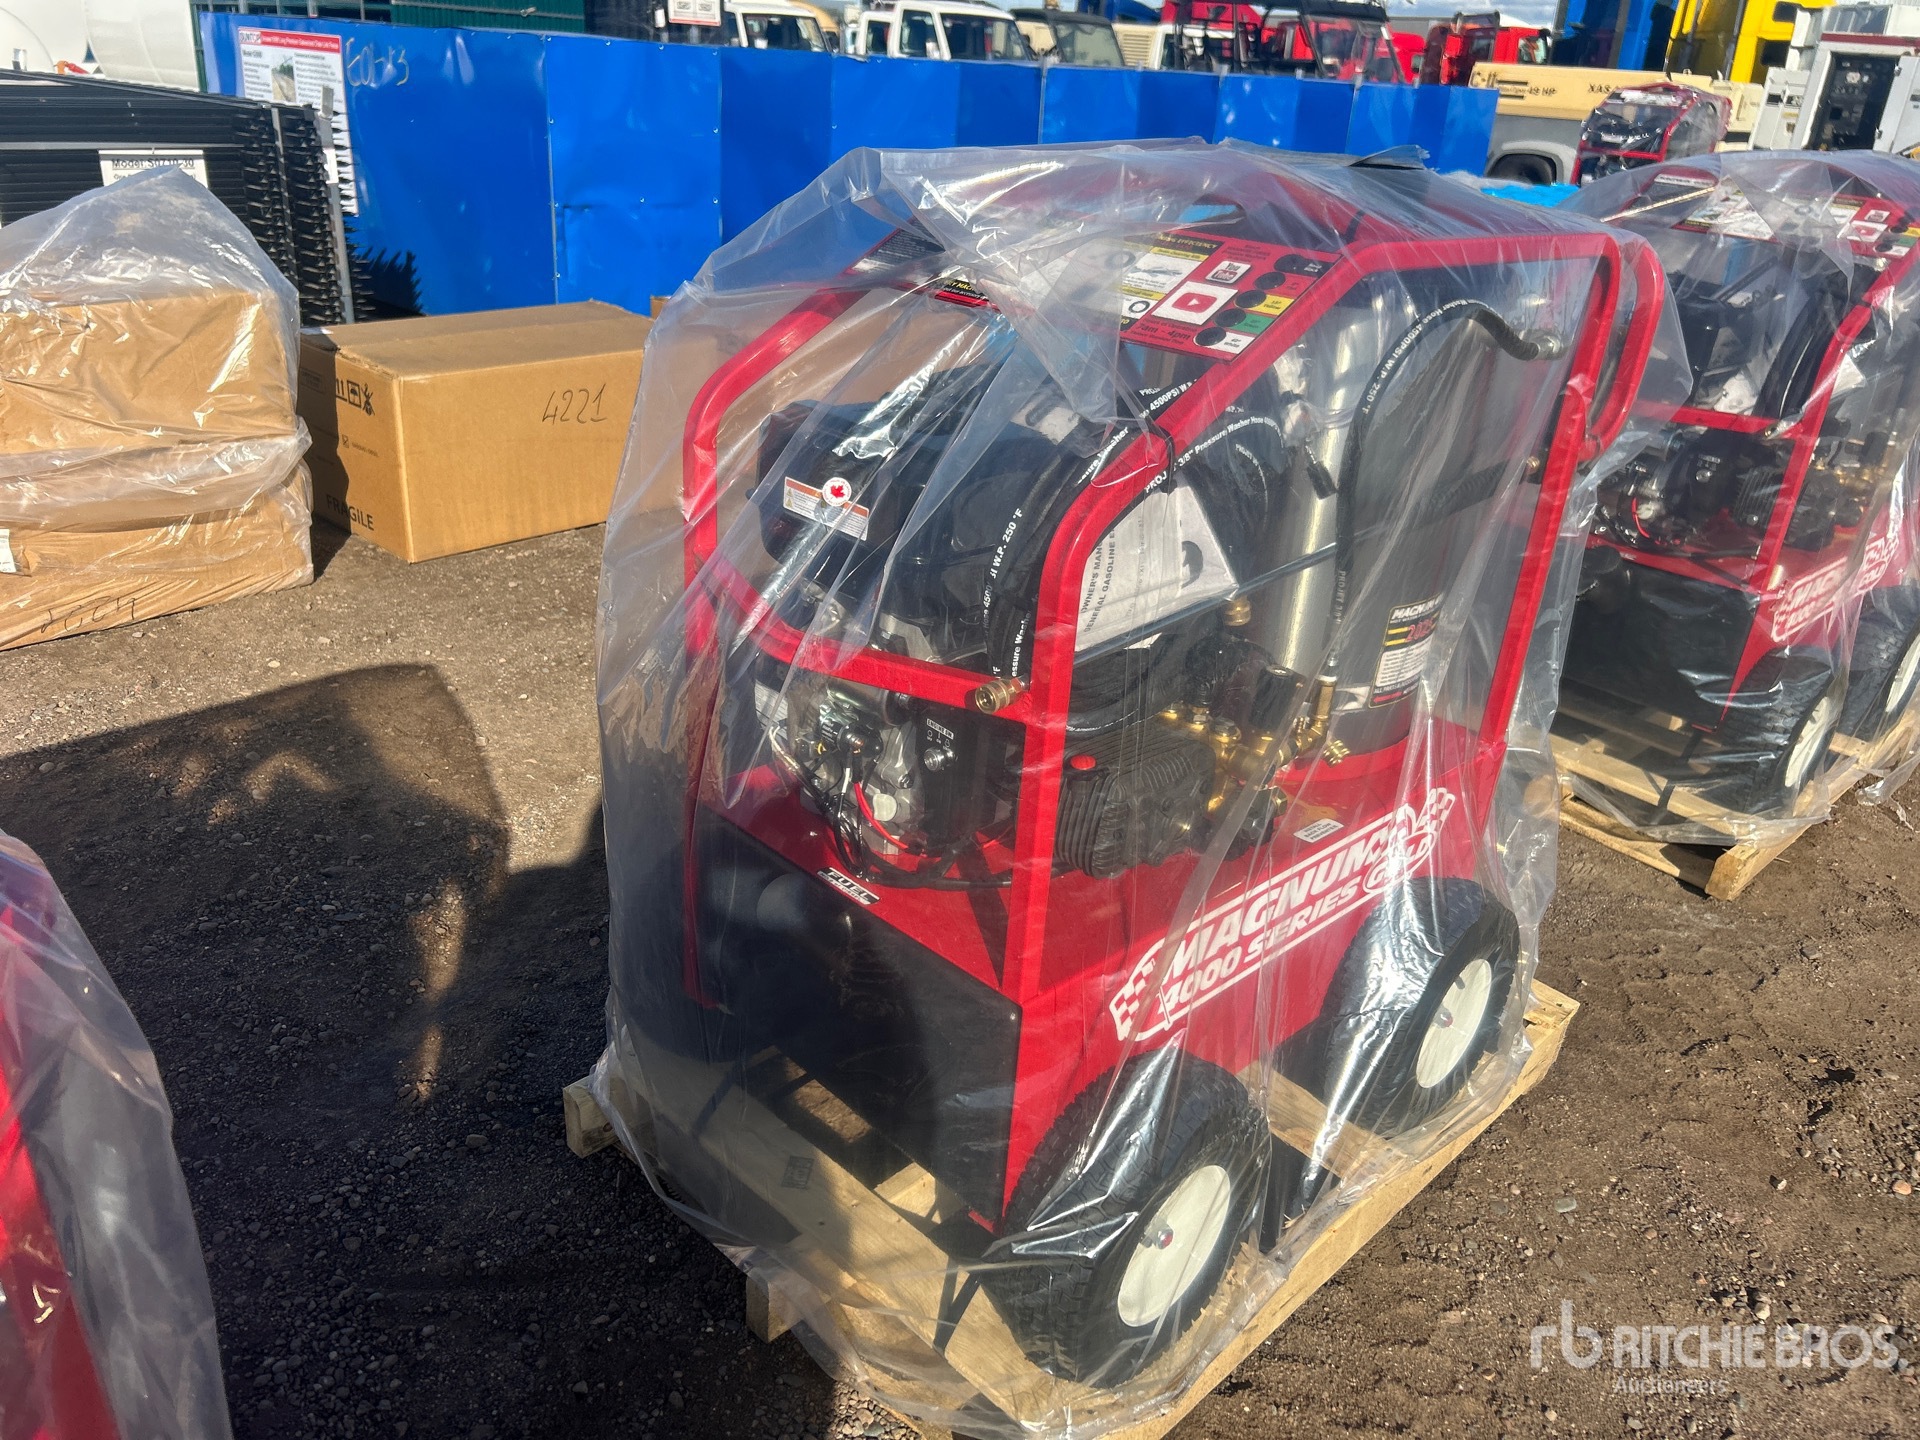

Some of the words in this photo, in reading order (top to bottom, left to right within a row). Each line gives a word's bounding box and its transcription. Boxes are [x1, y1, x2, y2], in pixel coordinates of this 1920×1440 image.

[1423, 308, 1444, 324] Hose
[1442, 299, 1468, 311] Washer
[1167, 330, 1191, 340] 4pm
[1392, 323, 1423, 359] 4500PSI
[541, 382, 608, 425] 4221
[1366, 382, 1382, 403] 250
[1194, 429, 1228, 455] Pressure
[1226, 418, 1251, 434] Washer
[1250, 415, 1264, 425] Hose
[325, 493, 375, 531] FRAGILE
[1002, 520, 1018, 543] 250
[1081, 572, 1100, 614] OWNER'S
[1084, 594, 1107, 633] GENERAL
[1101, 541, 1116, 592] GASOLINE
[1011, 646, 1021, 677] essure
[827, 871, 869, 901] FUEL
[1161, 824, 1402, 986] MAGNUM
[1157, 946, 1243, 1015] 4000
[1243, 875, 1361, 963] SERIES
